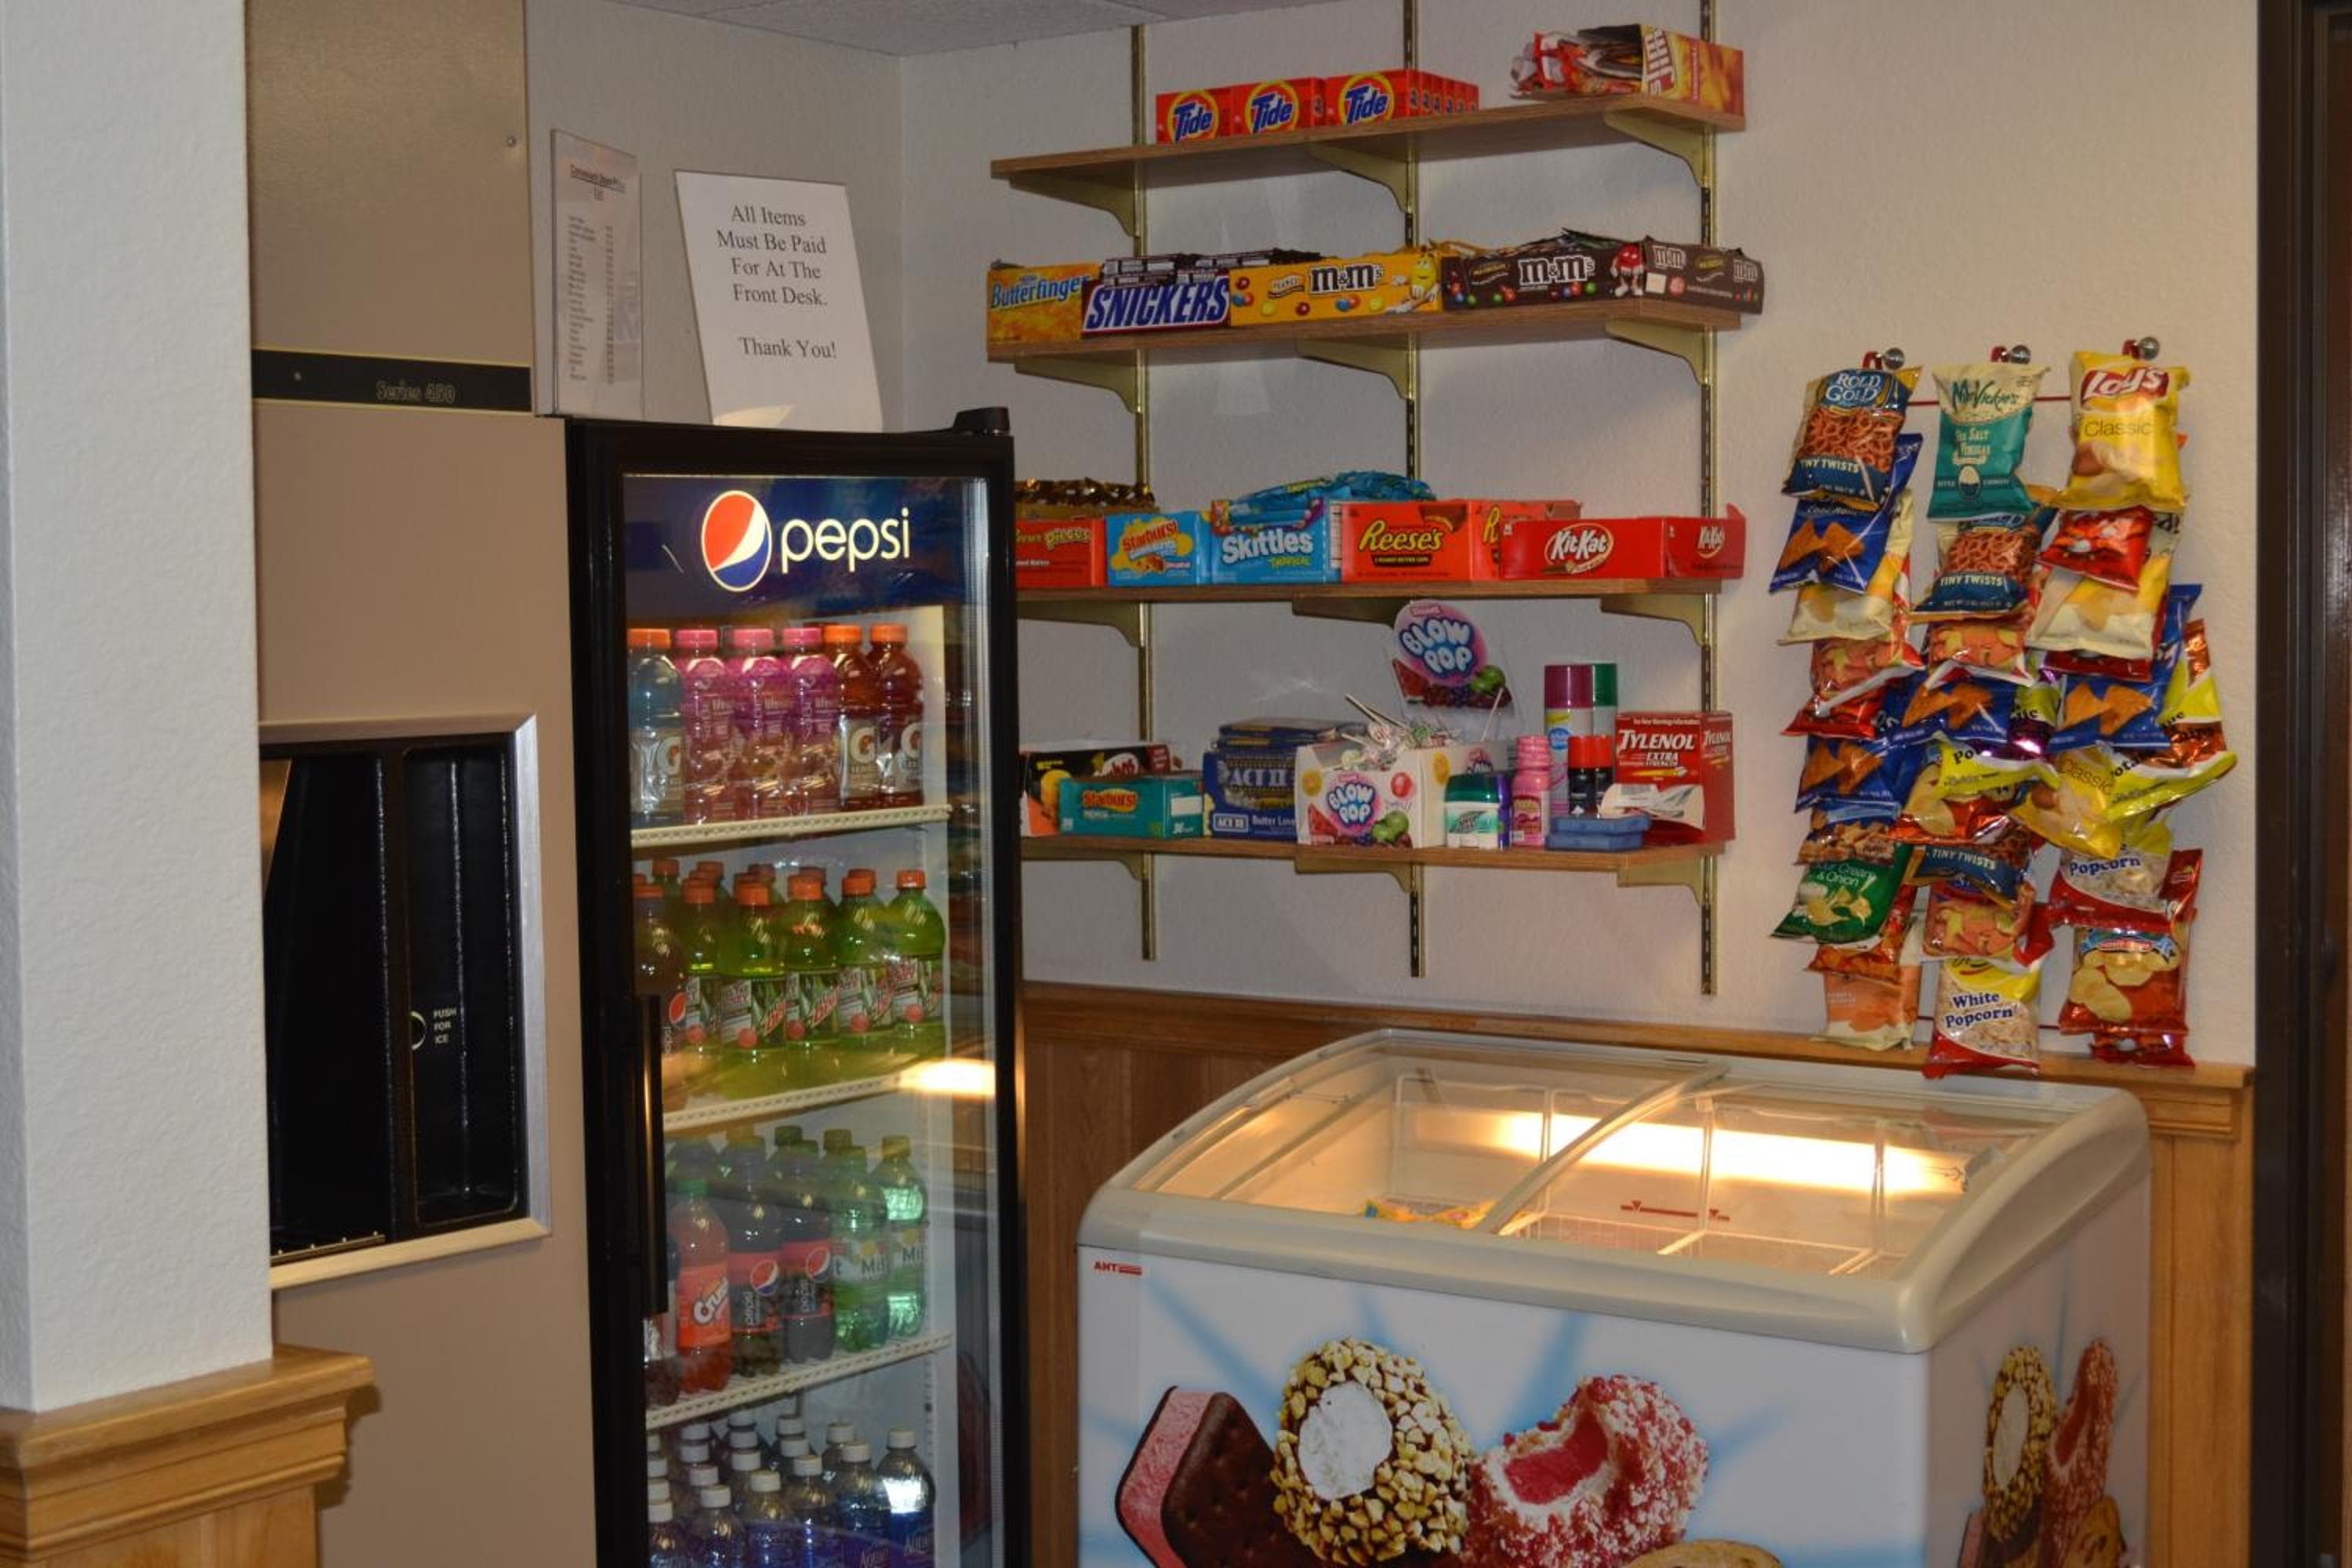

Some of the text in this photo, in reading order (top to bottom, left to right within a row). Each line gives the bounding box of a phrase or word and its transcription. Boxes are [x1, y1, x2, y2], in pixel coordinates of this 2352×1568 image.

[1251, 93, 1293, 132] Tide
[1345, 85, 1388, 125] Tide
[1175, 101, 1212, 141] Tide
[731, 205, 806, 227] All Items
[717, 230, 827, 254] Must Be Paid
[731, 258, 821, 279] For At The
[732, 284, 828, 306] Front Desk.
[1087, 276, 1229, 330] SNICKERS
[739, 337, 837, 358] Thank You!
[1837, 373, 1881, 388] ROLD
[2082, 367, 2162, 401] Lay's
[1826, 385, 1878, 402] GOLD
[2085, 419, 2152, 437] Classic
[1822, 459, 1859, 474] TWISTS
[782, 507, 910, 574] pepsi
[1123, 520, 1179, 551] Starburst
[1221, 528, 1313, 564] Skittles
[1359, 519, 1443, 552] Reese's
[1940, 575, 2002, 586] TINY TWISTS
[1401, 618, 1472, 657] BLOW
[1424, 645, 1474, 674] POP
[850, 726, 877, 764] G
[1618, 729, 1695, 750] TYLENOL
[1646, 752, 1679, 761] EXTRA
[1230, 768, 1265, 787] ACT
[1327, 782, 1376, 810] BLOW
[1338, 805, 1371, 824] POP
[1932, 848, 1996, 869] TINY TWISTS
[2069, 855, 2141, 876] Popcorn
[1826, 871, 1859, 887] Onion
[1952, 992, 1999, 1009] White
[433, 1007, 457, 1019] PUSH
[1944, 1007, 2013, 1028] Popcorn
[433, 1021, 452, 1031] FOR
[434, 1033, 450, 1044] ICE
[1094, 1261, 1117, 1272] AHT
